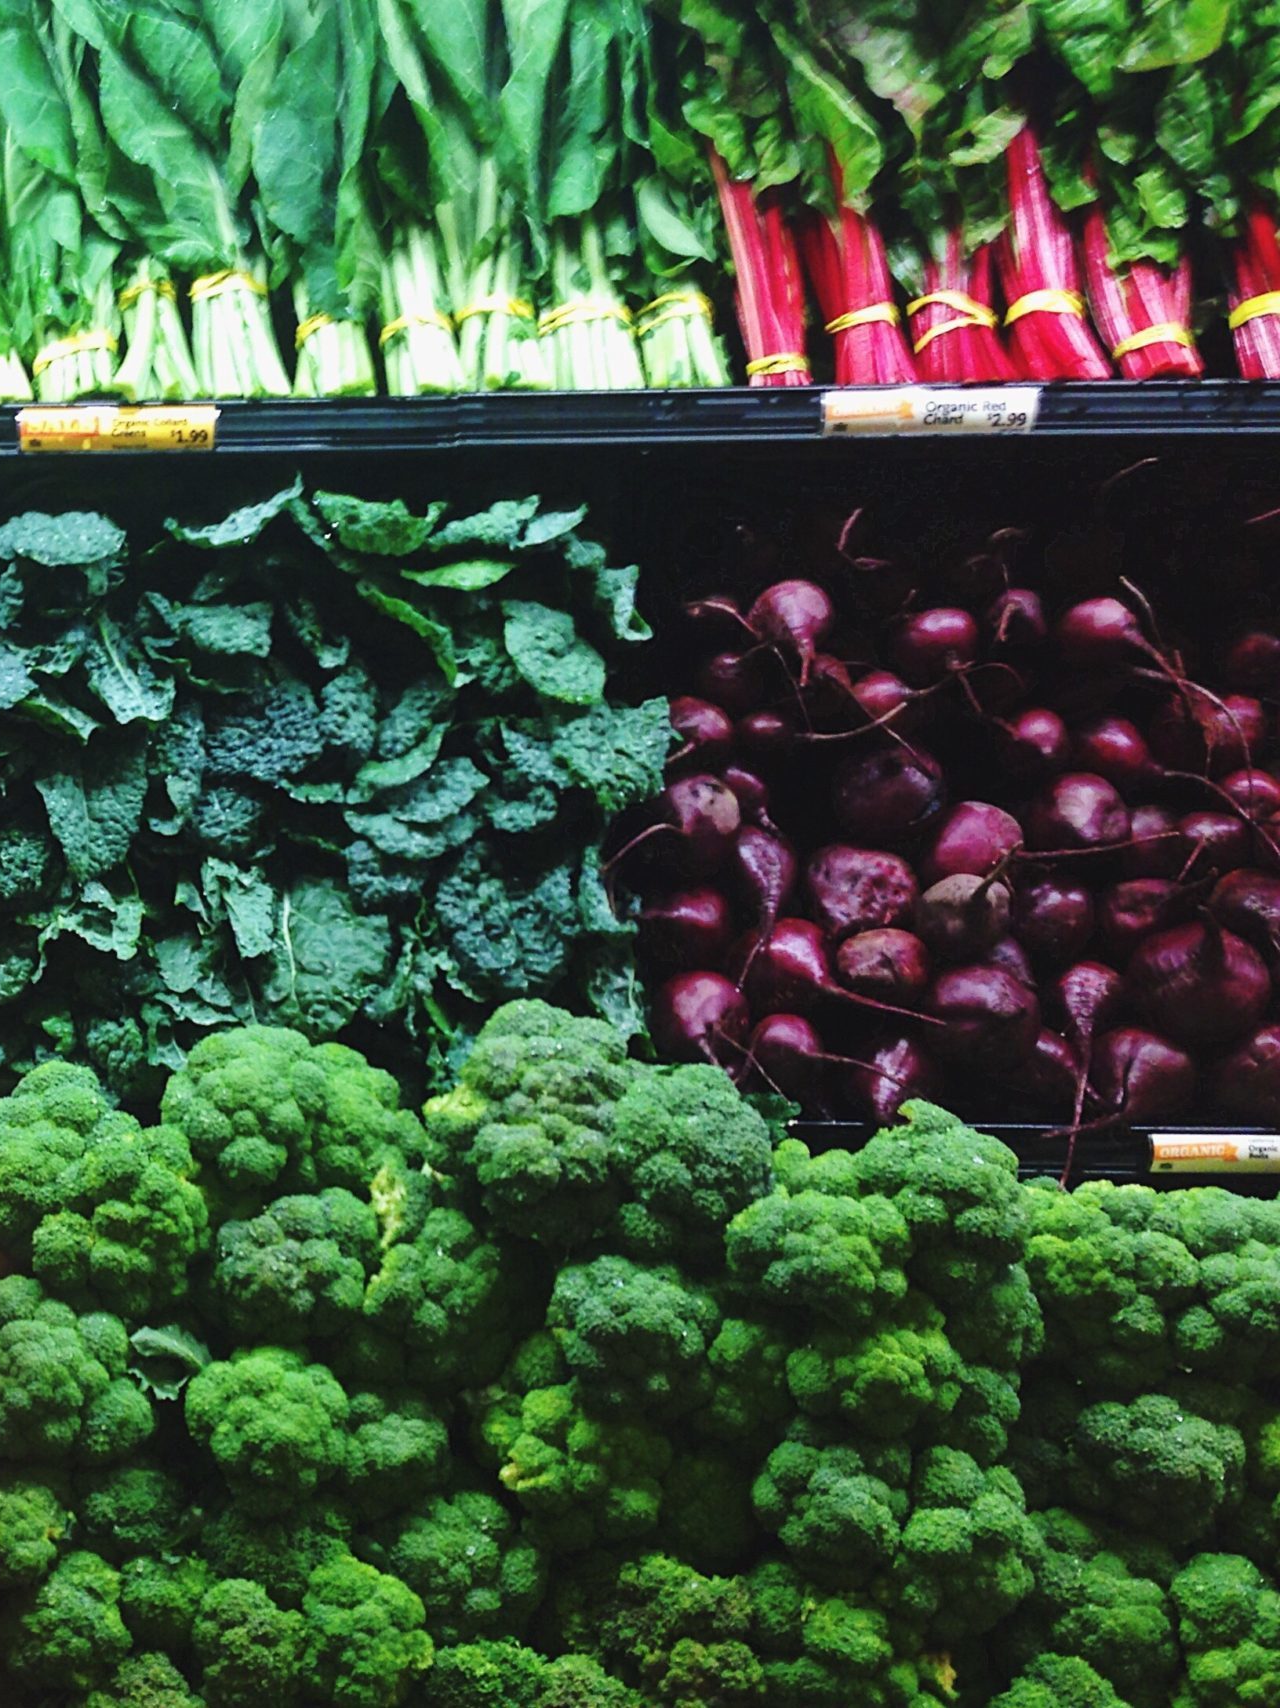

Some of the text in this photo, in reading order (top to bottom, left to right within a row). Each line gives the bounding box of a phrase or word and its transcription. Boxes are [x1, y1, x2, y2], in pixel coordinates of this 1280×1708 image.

[926, 401, 1007, 416] Organic Red
[923, 412, 1027, 427] Chard $2.99
[170, 429, 208, 443] $1.99
[1160, 1145, 1225, 1157] ORGANIC
[1248, 1144, 1278, 1155] Organic
